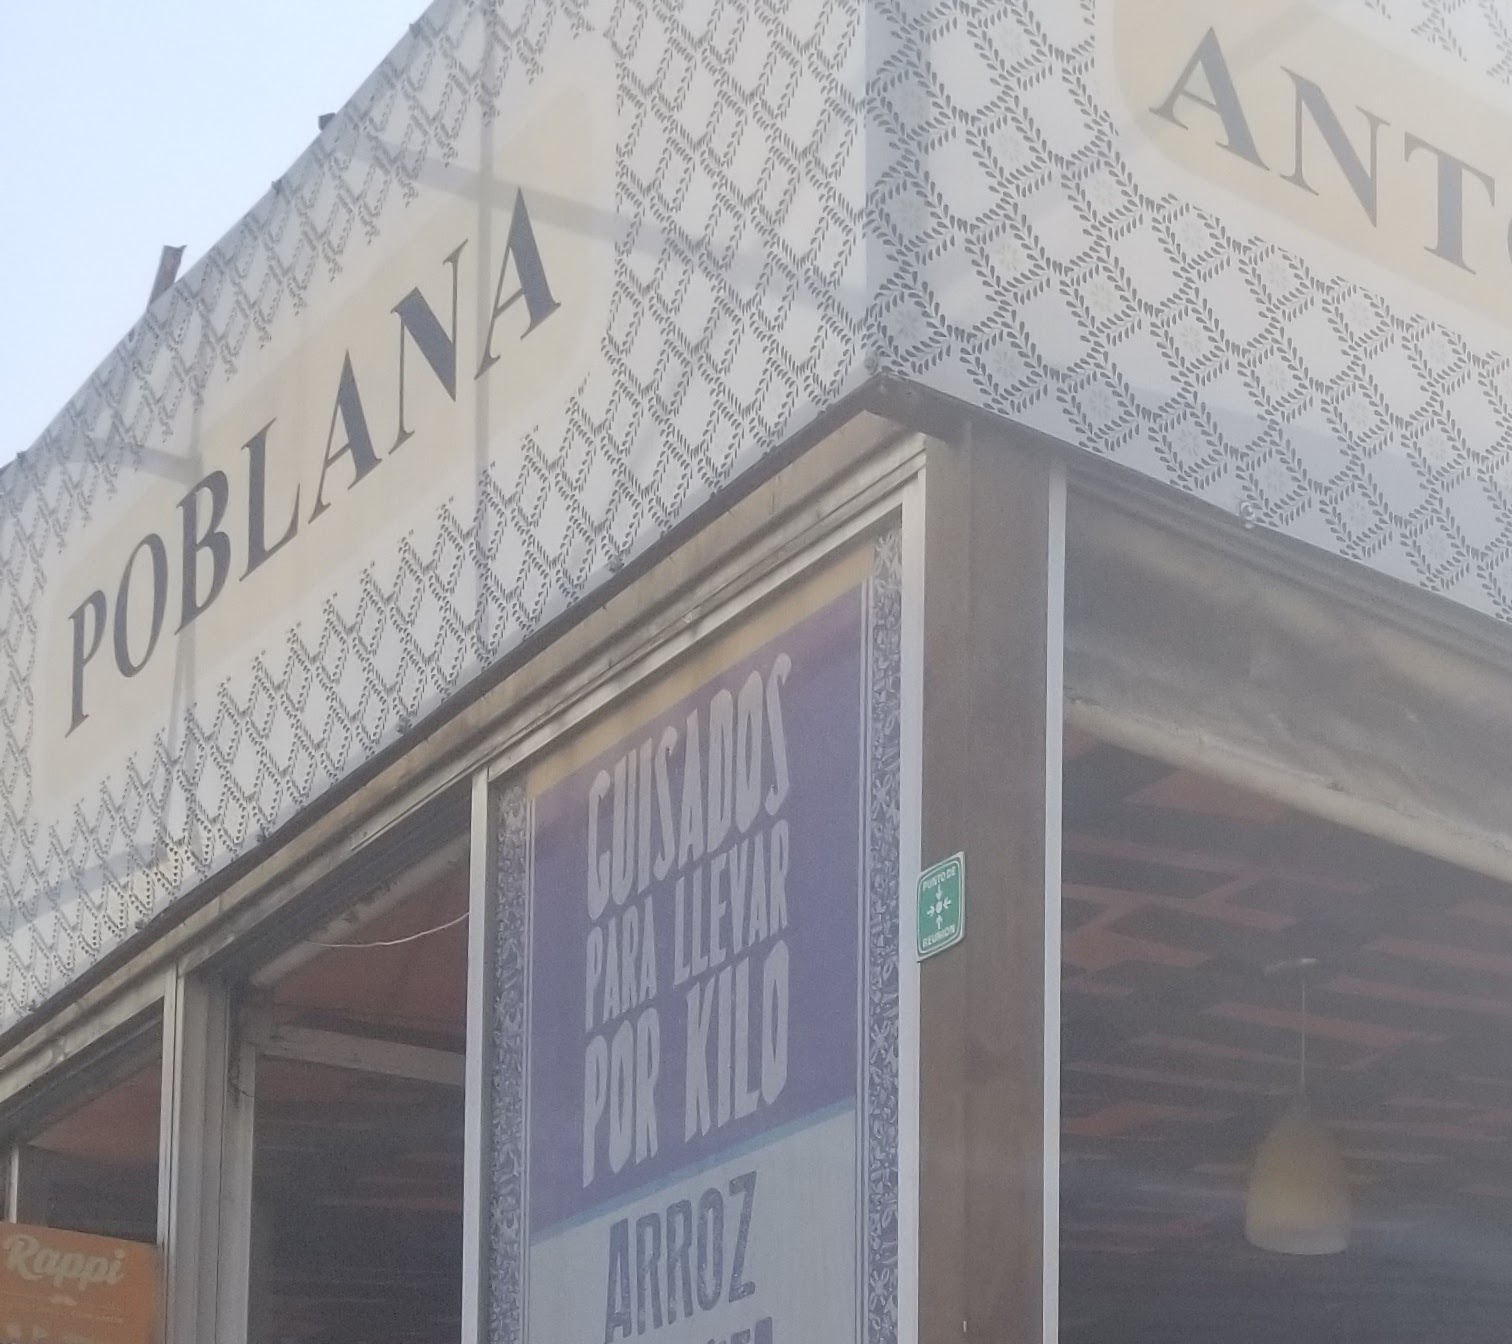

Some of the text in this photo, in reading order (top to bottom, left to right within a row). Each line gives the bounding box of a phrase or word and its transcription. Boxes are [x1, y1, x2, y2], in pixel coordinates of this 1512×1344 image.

[65, 187, 562, 738] POBLANA
[588, 652, 792, 920] GUISADOS
[922, 865, 957, 891] PUNTO DE
[585, 819, 790, 1034] PARA LLEVAR
[582, 939, 790, 1189] POR KILO
[3, 1234, 127, 1291] Rappi
[604, 1170, 758, 1344] ARROZ
